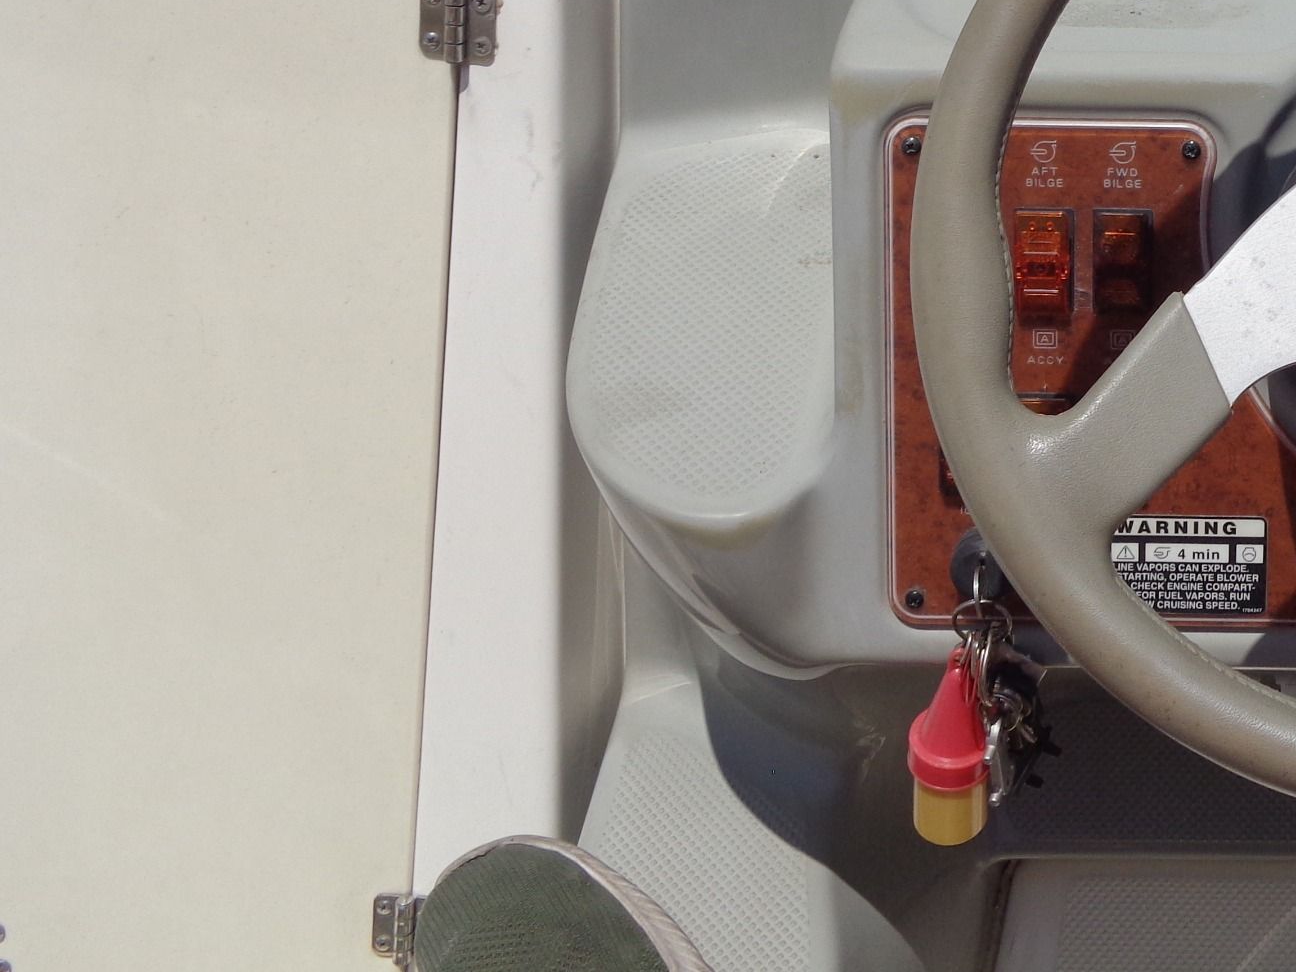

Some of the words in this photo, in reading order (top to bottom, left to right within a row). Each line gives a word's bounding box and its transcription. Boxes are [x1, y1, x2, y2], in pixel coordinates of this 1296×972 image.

[1031, 166, 1059, 176] AFT
[1107, 167, 1138, 177] FWD
[1025, 178, 1064, 188] BILGE
[1103, 178, 1142, 189] BILGE
[1027, 355, 1064, 365] ACCY
[1118, 520, 1237, 535] WARNING
[1178, 548, 1186, 560] 4
[1192, 548, 1220, 560] min
[1136, 563, 1176, 572] VAPORS
[1178, 563, 1199, 572] CAN
[1201, 564, 1249, 573] EXPLODE.
[1169, 573, 1215, 582] OPERATE
[1216, 573, 1259, 583] BLOWER
[1130, 582, 1164, 590] CHECK
[1167, 582, 1203, 591] ENGINE
[1205, 583, 1256, 592] COMPART-
[1136, 591, 1156, 599] FOR
[1158, 591, 1183, 600] FUEL
[1185, 592, 1228, 601] VAPORS.
[1229, 592, 1251, 601] RUN
[1156, 600, 1204, 609] CRUISING
[1205, 601, 1241, 610] SPEED.
